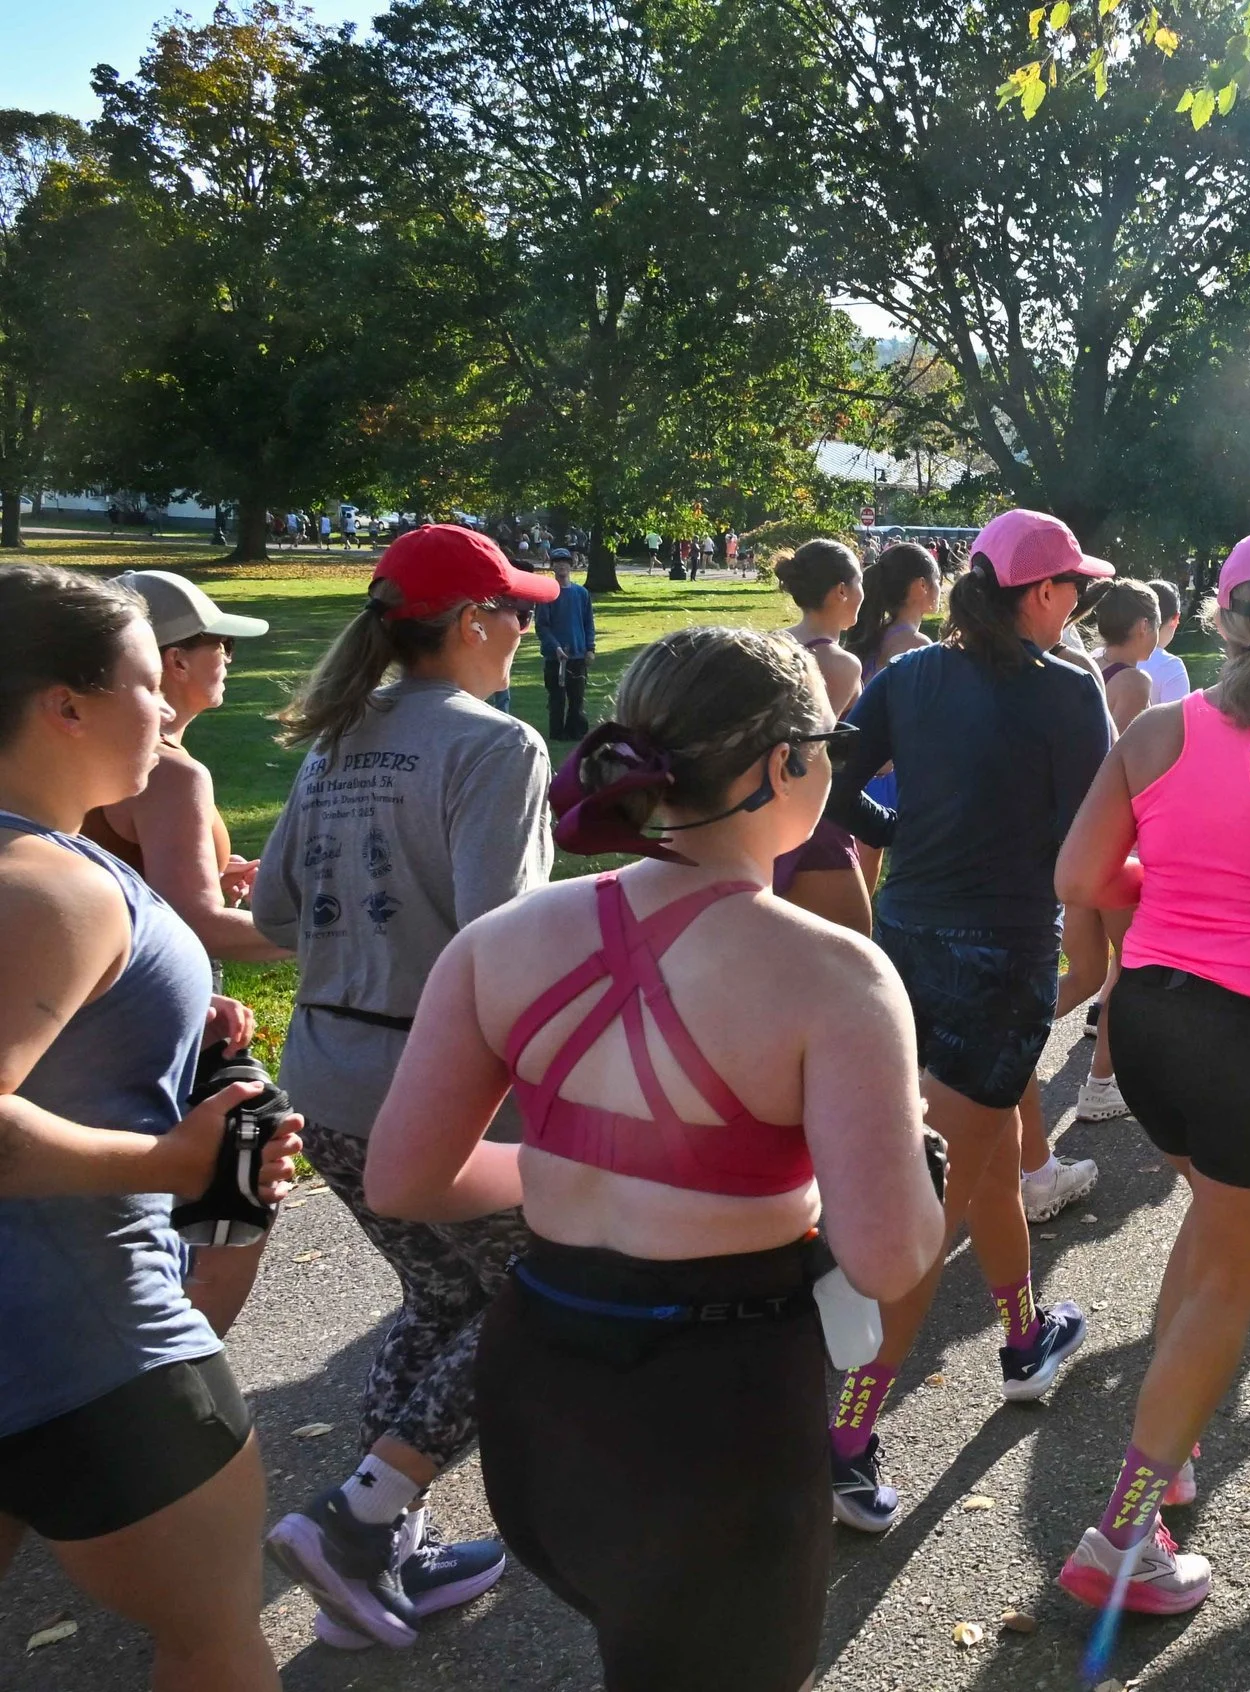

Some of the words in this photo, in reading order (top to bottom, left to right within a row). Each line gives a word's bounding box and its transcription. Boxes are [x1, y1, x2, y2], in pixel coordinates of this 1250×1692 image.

[306, 781, 325, 796] Half
[379, 775, 393, 788] 5K
[343, 751, 420, 773] PEEPERS
[997, 1298, 1011, 1336] PACE
[1017, 1285, 1029, 1336] PARTY
[850, 1376, 877, 1428] PACE
[1112, 1466, 1154, 1529] PARTY
[1132, 1478, 1168, 1526] PACE
